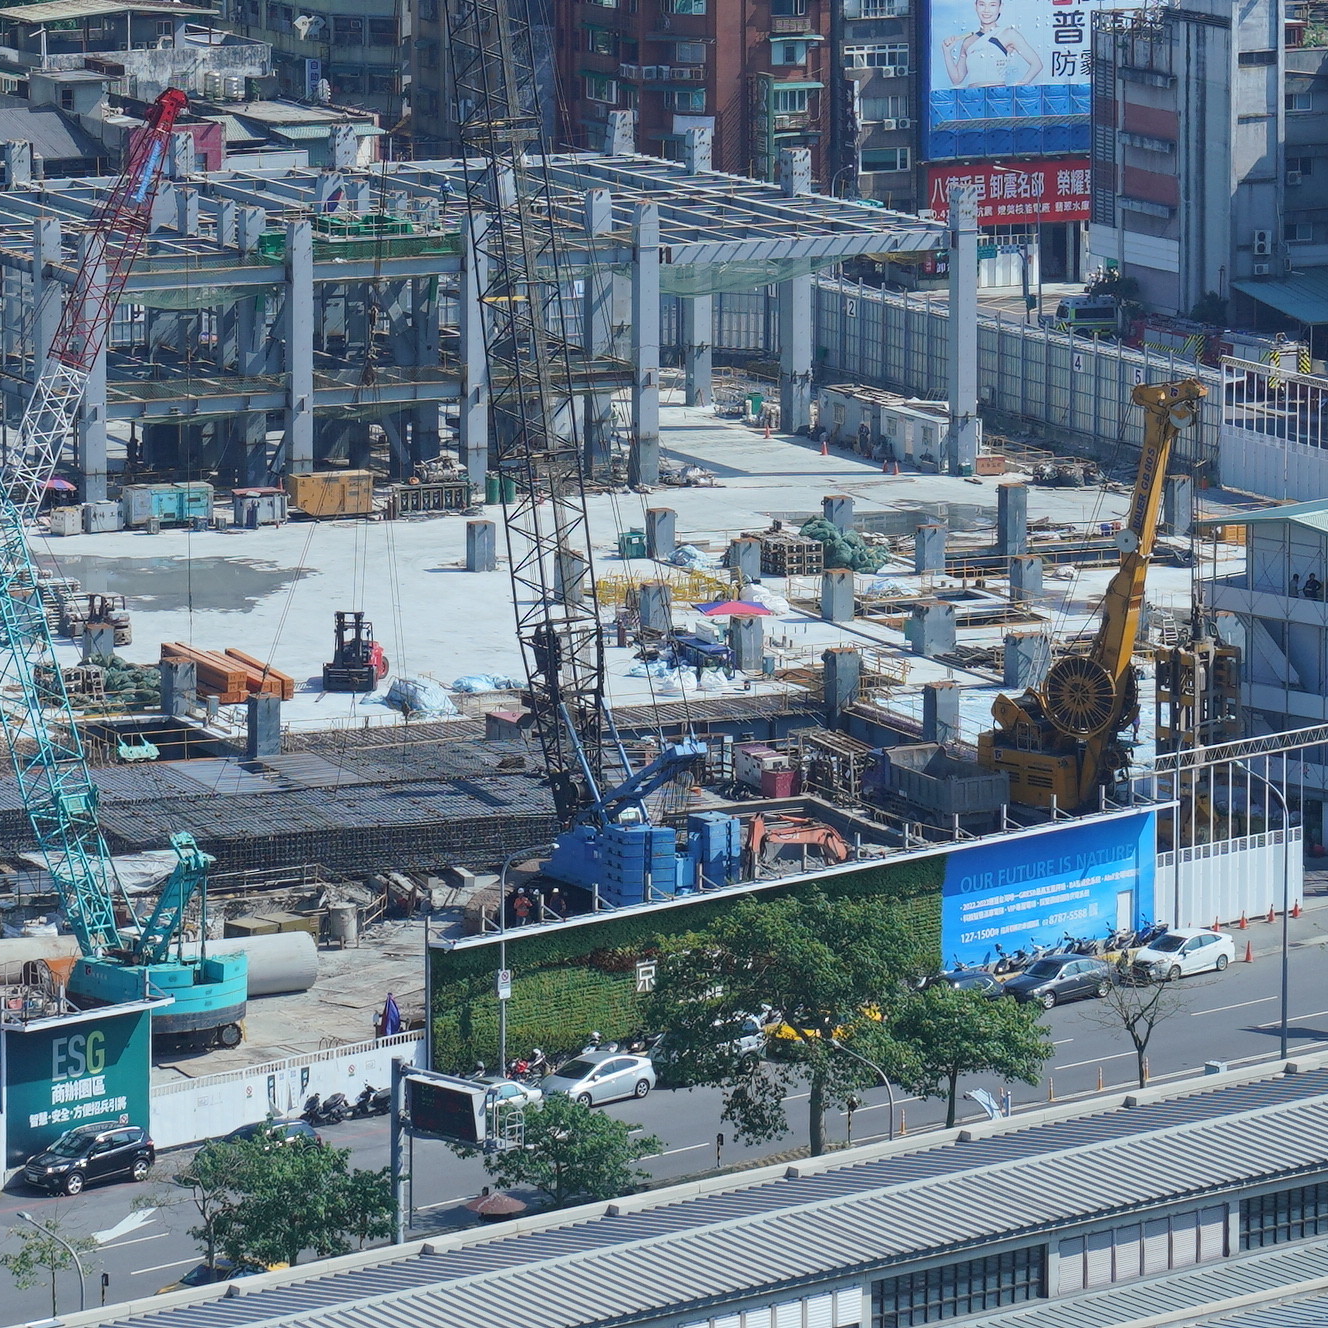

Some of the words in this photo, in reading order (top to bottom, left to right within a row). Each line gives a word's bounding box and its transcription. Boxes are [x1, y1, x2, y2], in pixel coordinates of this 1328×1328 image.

[848, 301, 855, 315] 2
[1074, 355, 1082, 369] 4
[1135, 370, 1142, 384] 5
[960, 871, 994, 894] OUR
[998, 858, 1055, 887] FUTURE
[1059, 855, 1072, 875] IS
[1075, 843, 1135, 870] NATURE
[1048, 907, 1088, 926] 8787-5588
[51, 1030, 106, 1082] ESG
[50, 1074, 106, 1105] 商辦園區
